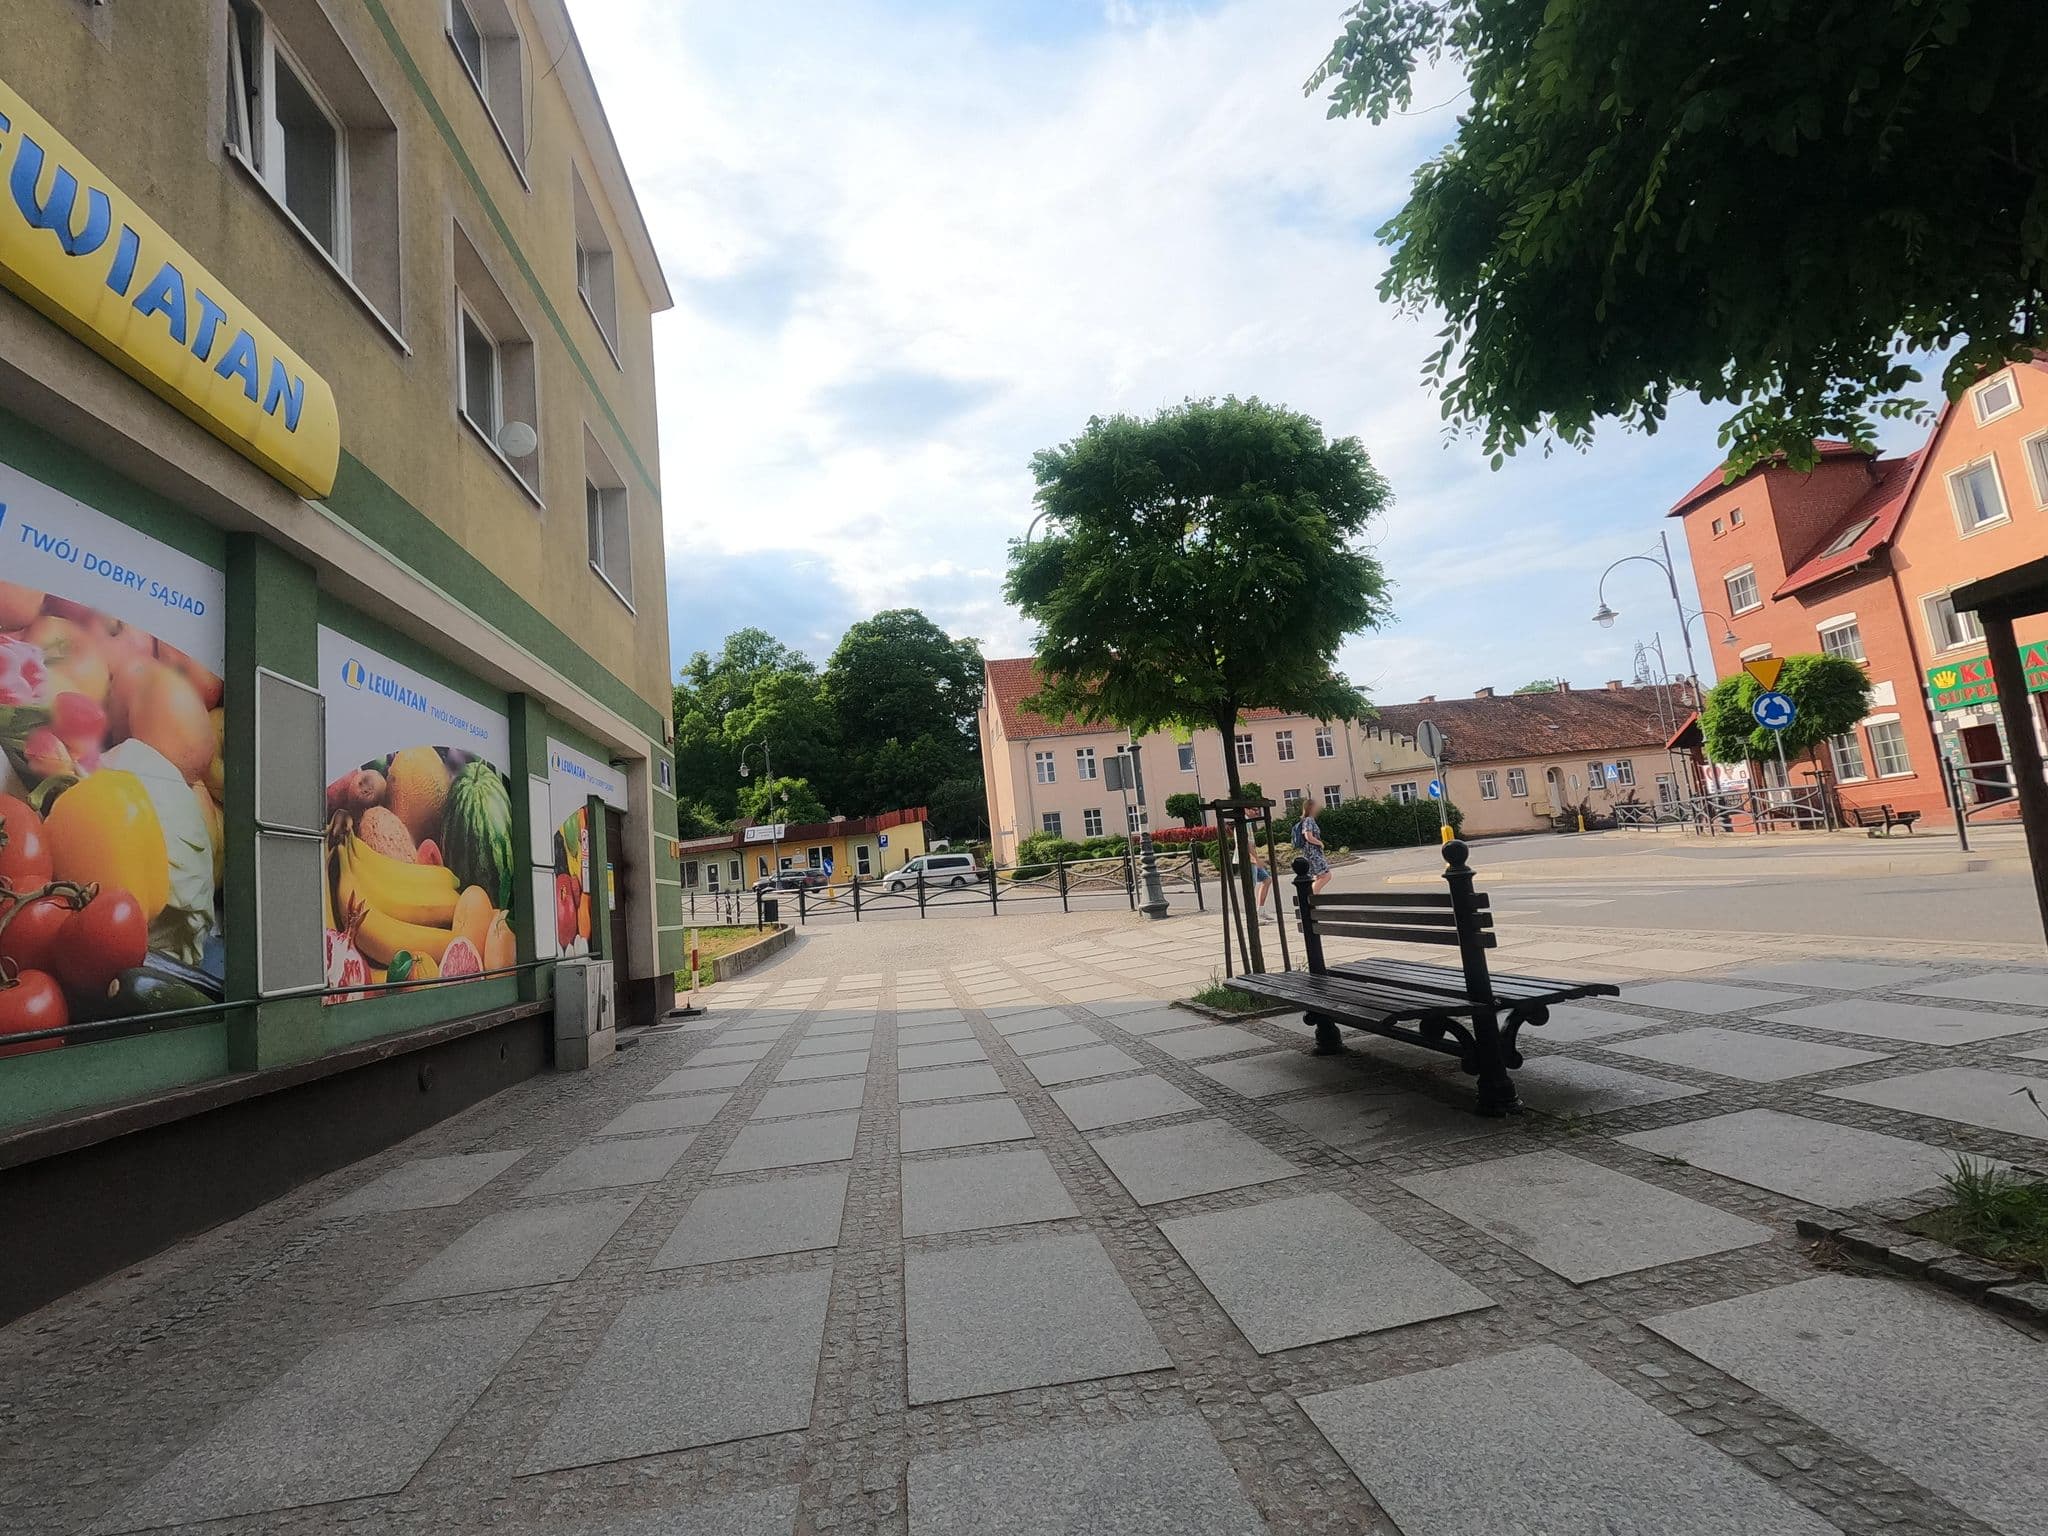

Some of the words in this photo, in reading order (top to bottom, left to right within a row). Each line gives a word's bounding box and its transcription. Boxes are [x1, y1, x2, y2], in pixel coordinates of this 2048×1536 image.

[0, 112, 305, 433] WIATAN
[20, 523, 79, 563] TWÓJ
[83, 552, 147, 591] DOBRY
[149, 581, 205, 616] SĄSIAD
[368, 672, 427, 712] LEWIATAN
